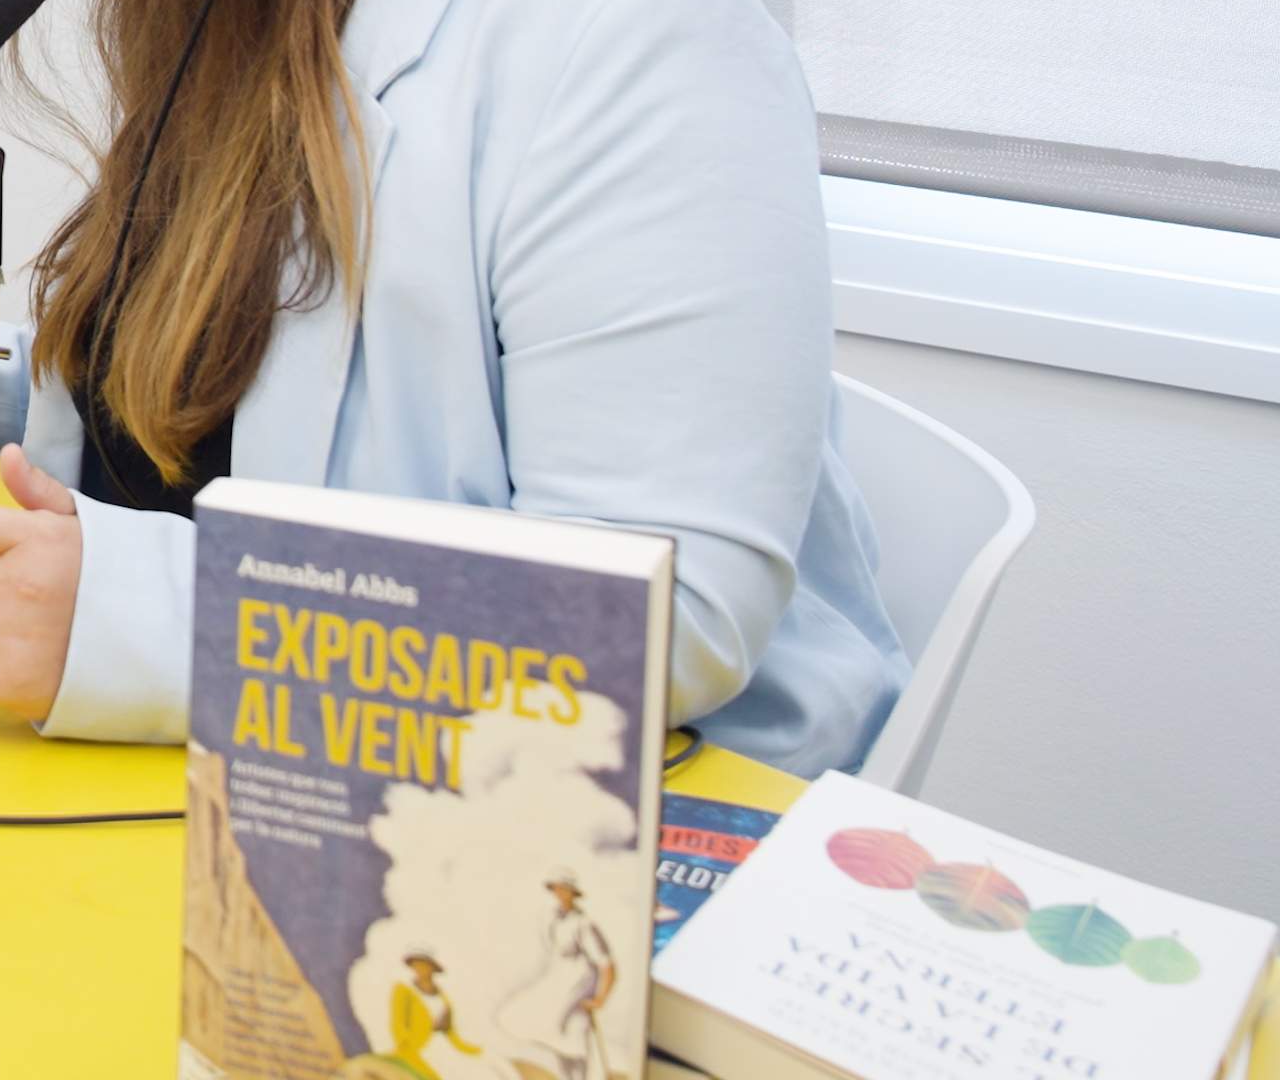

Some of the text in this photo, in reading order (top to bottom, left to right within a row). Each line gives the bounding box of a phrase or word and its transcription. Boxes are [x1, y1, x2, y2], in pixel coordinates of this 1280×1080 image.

[237, 553, 419, 609] Annabel Abbs
[236, 597, 588, 728] EXPOSADES
[232, 677, 474, 794] AL VENT
